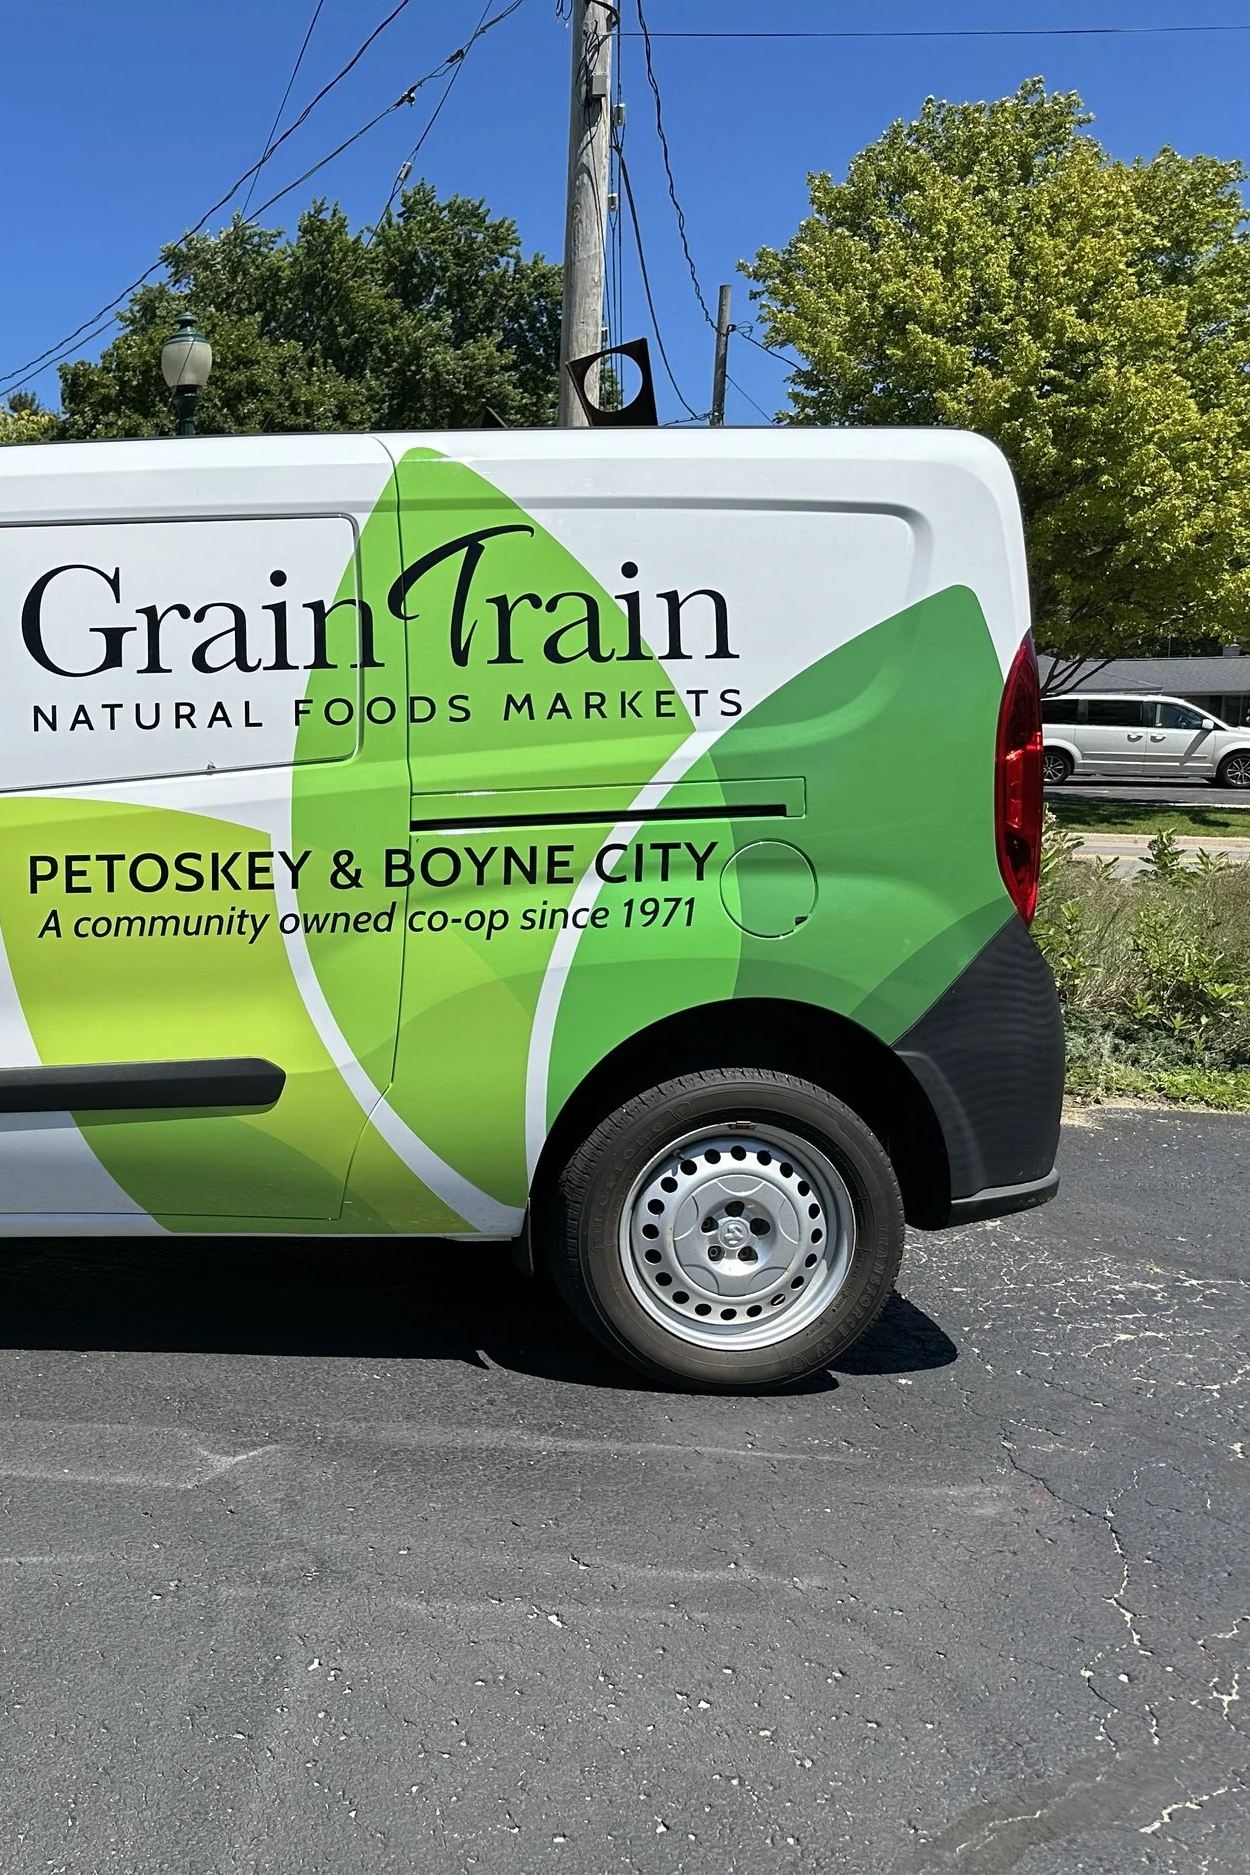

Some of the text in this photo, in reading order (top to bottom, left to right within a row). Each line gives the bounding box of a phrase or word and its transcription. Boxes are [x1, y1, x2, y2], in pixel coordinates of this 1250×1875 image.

[33, 688, 743, 732] NATURAL FOODS MARKETS
[29, 841, 719, 895] PETOSKEY & BOYNE CITY
[37, 897, 696, 946] A community owned co-op since 1971
